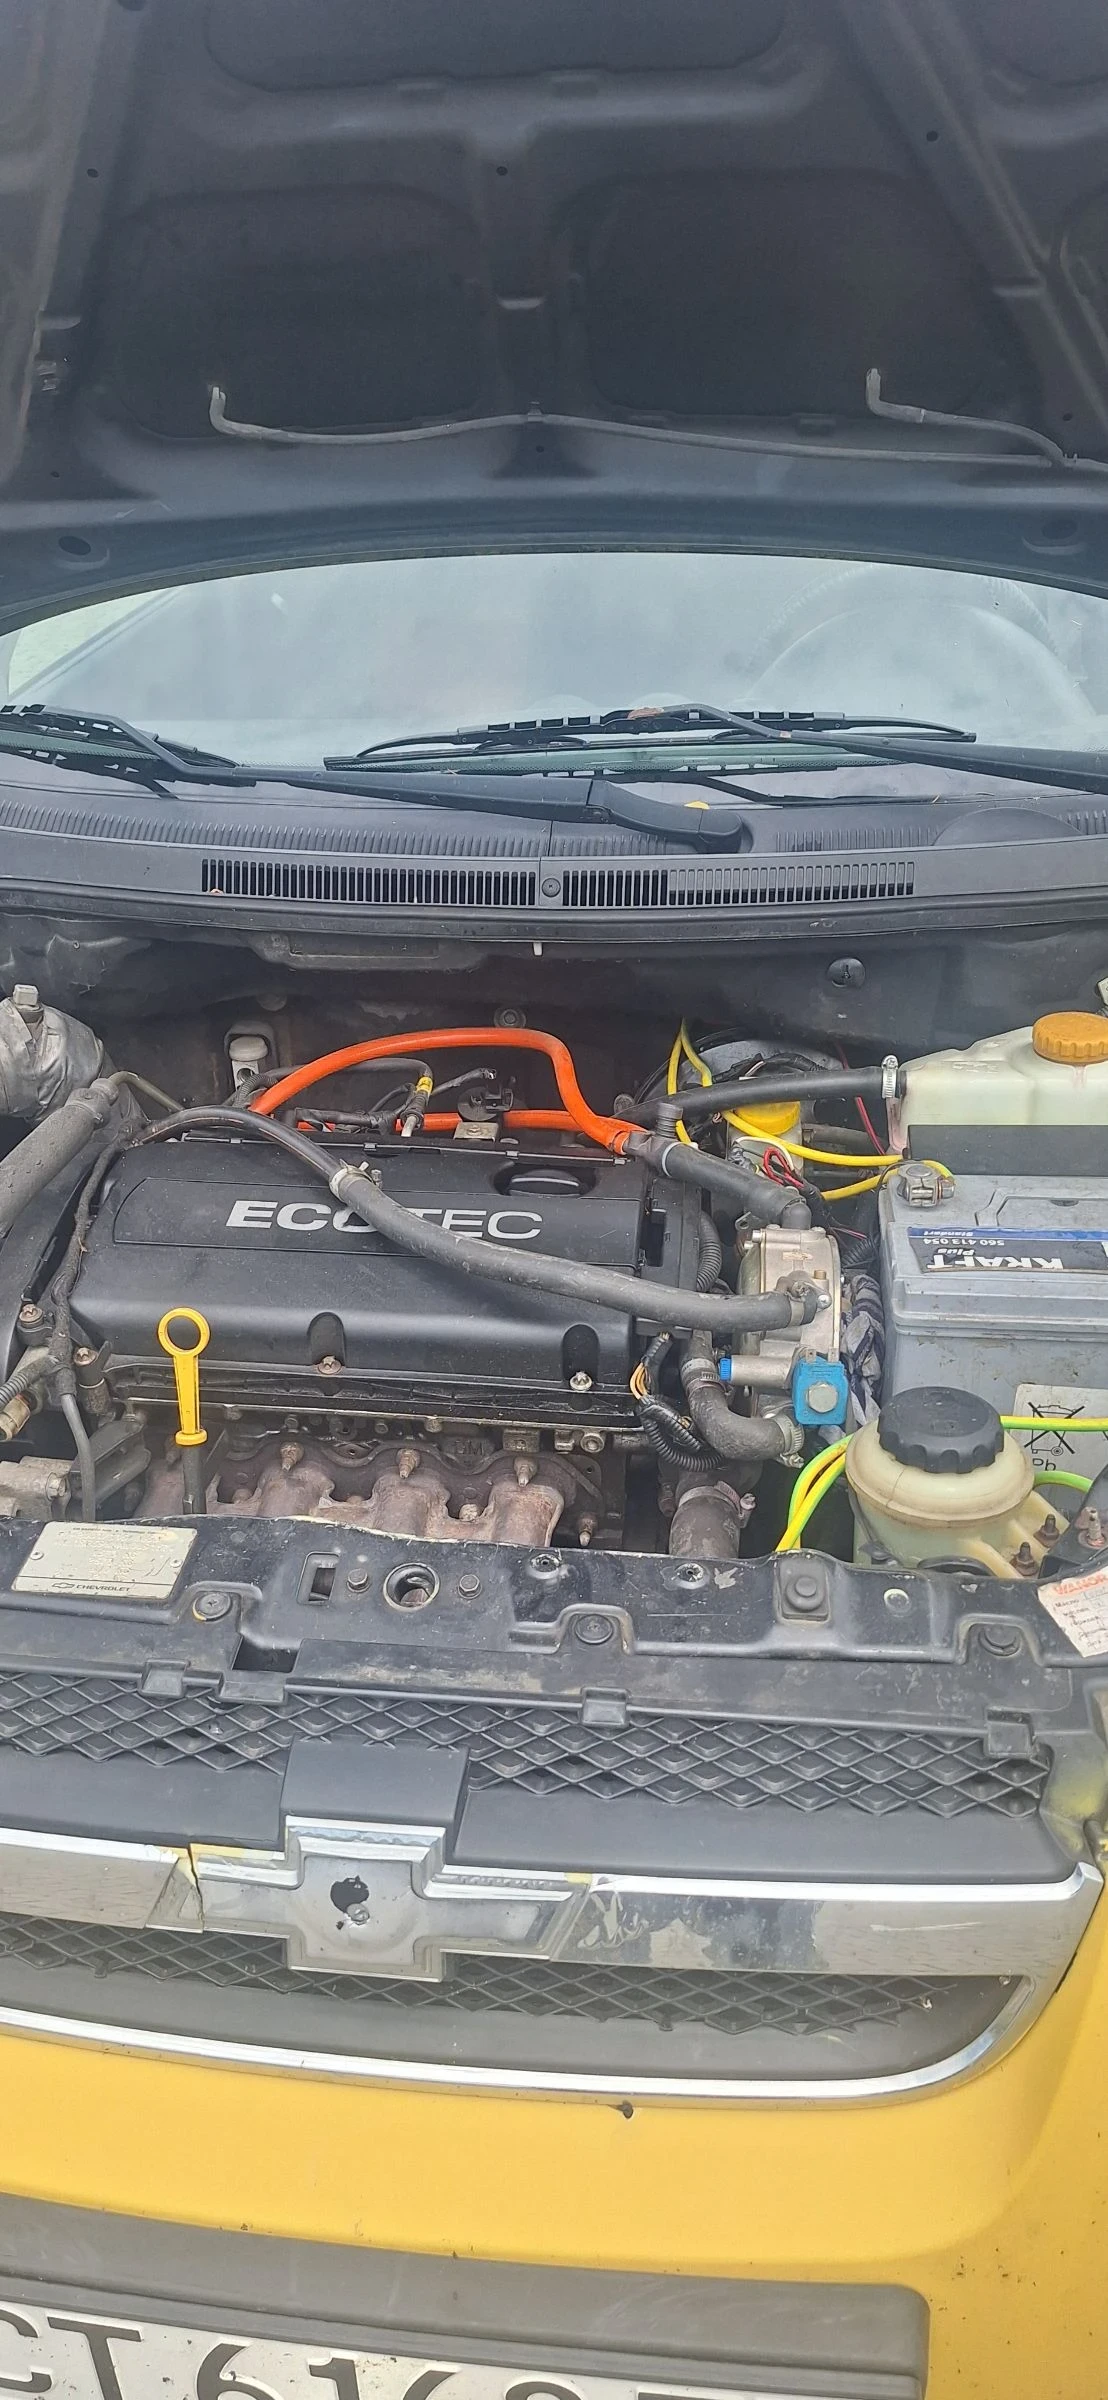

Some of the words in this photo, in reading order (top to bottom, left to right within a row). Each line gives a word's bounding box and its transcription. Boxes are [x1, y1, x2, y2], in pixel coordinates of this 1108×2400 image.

[950, 1238, 979, 1246] 413
[937, 1248, 975, 1256] Plus
[927, 1254, 1064, 1270] KRAFT
[1032, 1457, 1057, 1471] Pb
[76, 1584, 130, 1592] CHEVROLET
